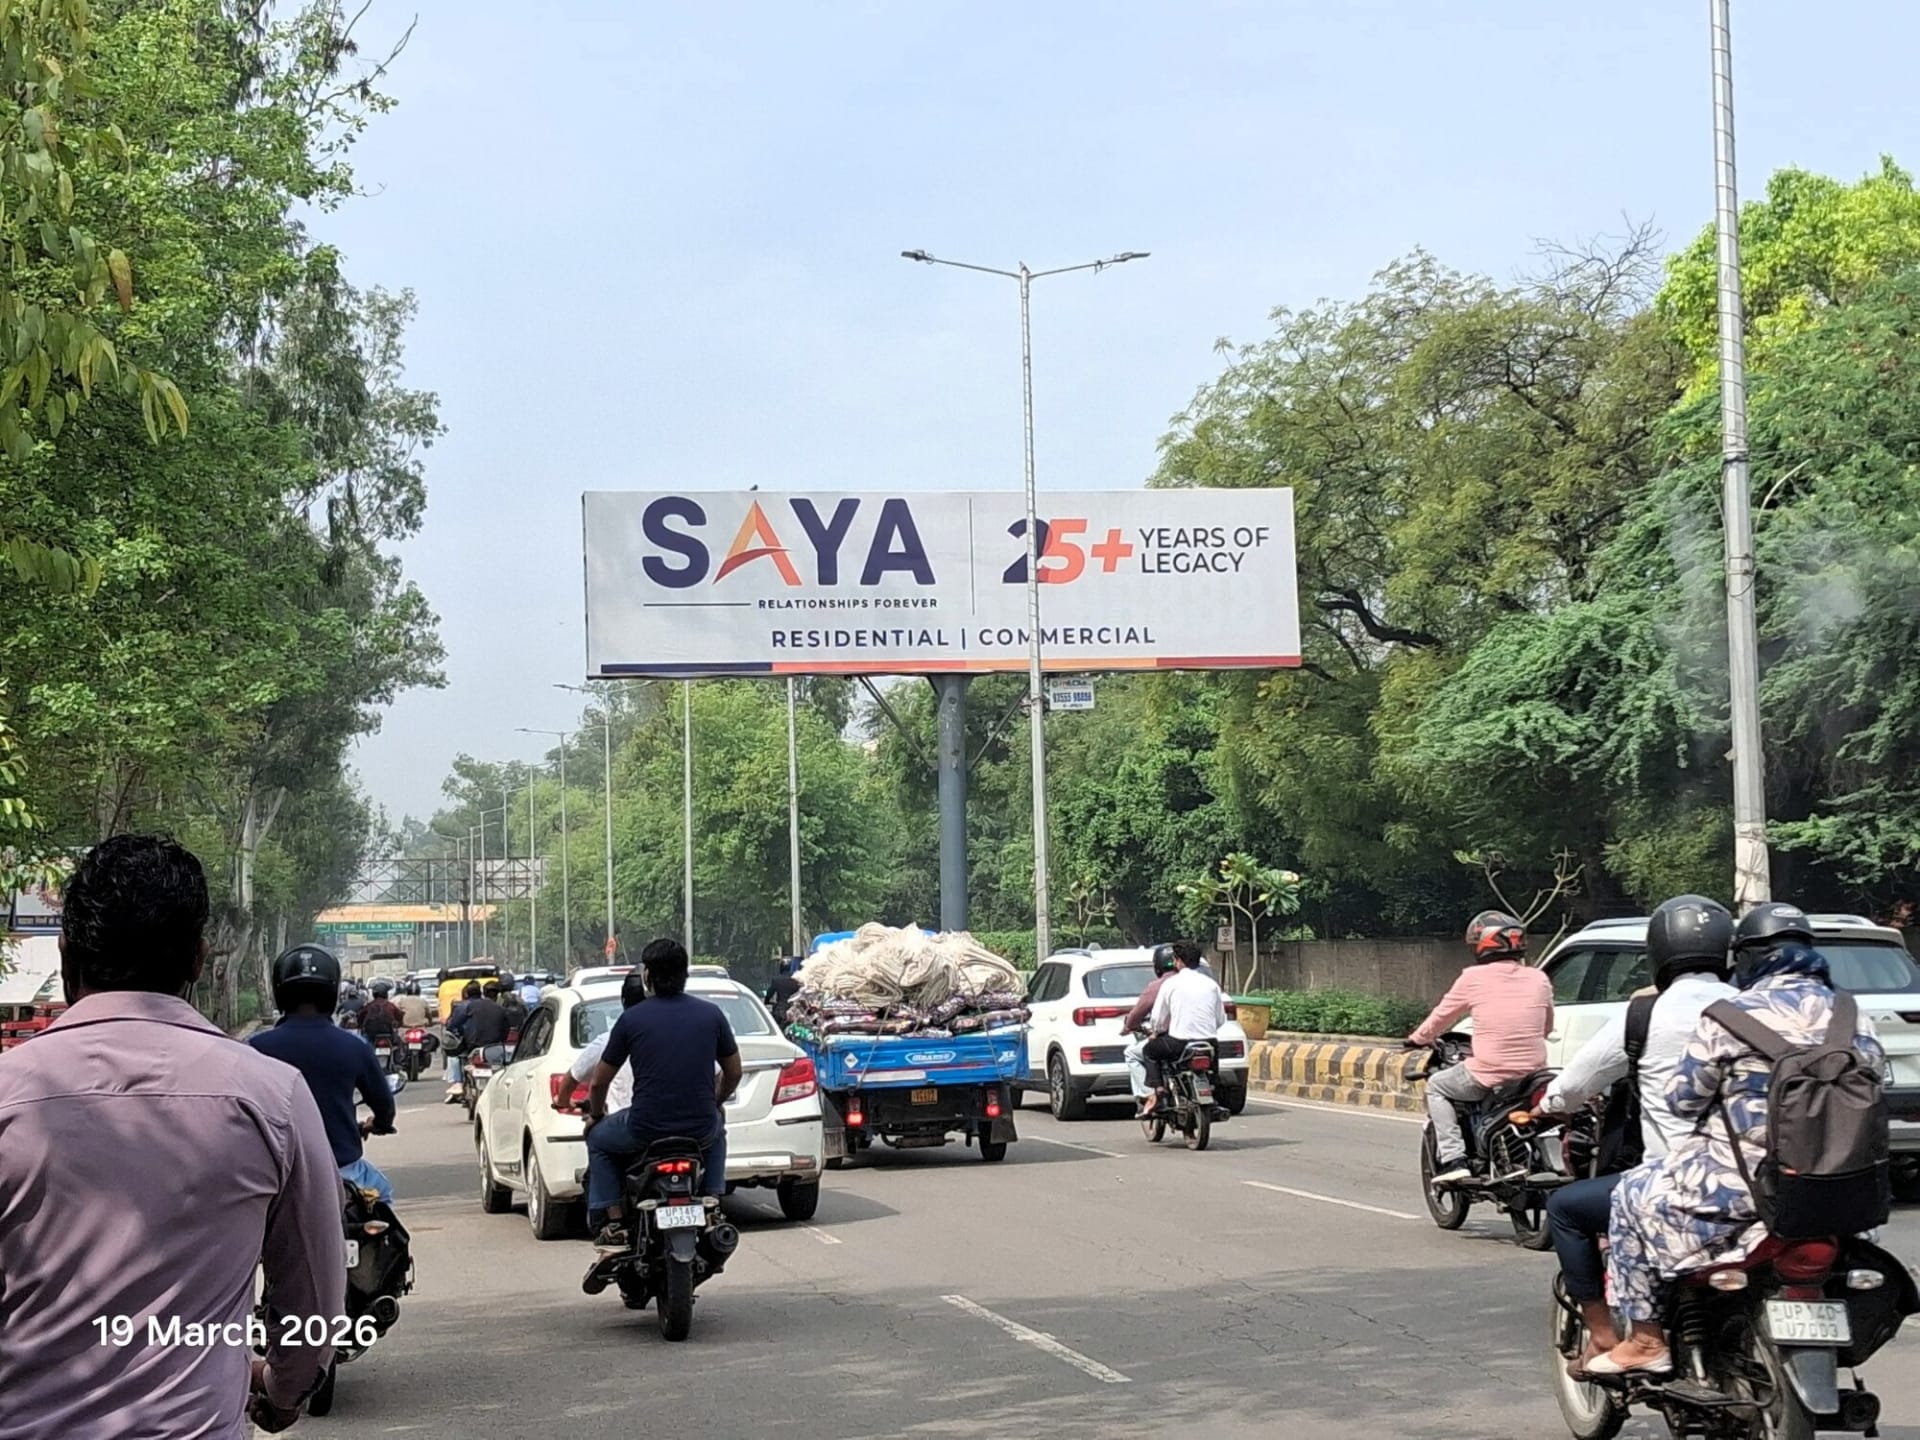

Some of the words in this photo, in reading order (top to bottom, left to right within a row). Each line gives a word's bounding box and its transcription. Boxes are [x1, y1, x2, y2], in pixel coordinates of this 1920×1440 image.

[642, 496, 935, 588] SAYA
[1139, 528, 1225, 549] YEARS
[1234, 527, 1269, 548] OF
[1141, 552, 1245, 574] LEGACY
[759, 599, 868, 609] RELATIONSHIPS
[874, 599, 938, 609] FOREVER
[772, 629, 949, 648] RESIDENTIAL
[979, 627, 1156, 646] COMMERCIAL
